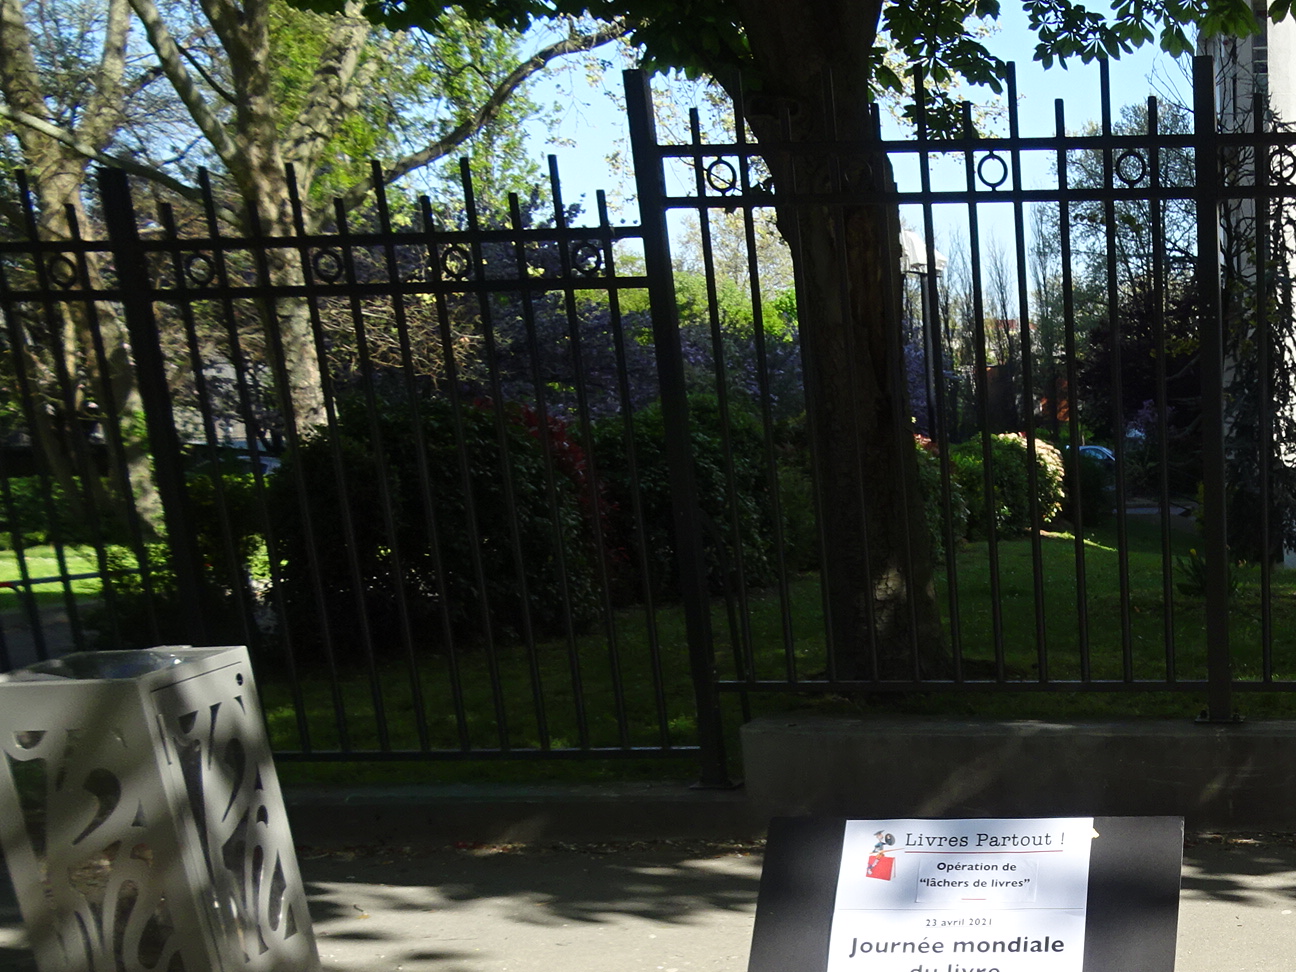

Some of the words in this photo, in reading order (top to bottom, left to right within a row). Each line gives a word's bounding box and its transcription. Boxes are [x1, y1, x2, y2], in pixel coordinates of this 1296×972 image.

[904, 832, 969, 848] Livres
[975, 832, 1053, 848] Partout
[1060, 832, 1065, 846] !
[936, 861, 999, 873] Opération
[1001, 861, 1017, 872] de
[972, 878, 988, 888] de
[925, 918, 938, 927] 23
[940, 918, 965, 927] avril
[968, 917, 993, 926] 2021
[849, 936, 945, 958] Journée
[953, 936, 1065, 953] mondiale
